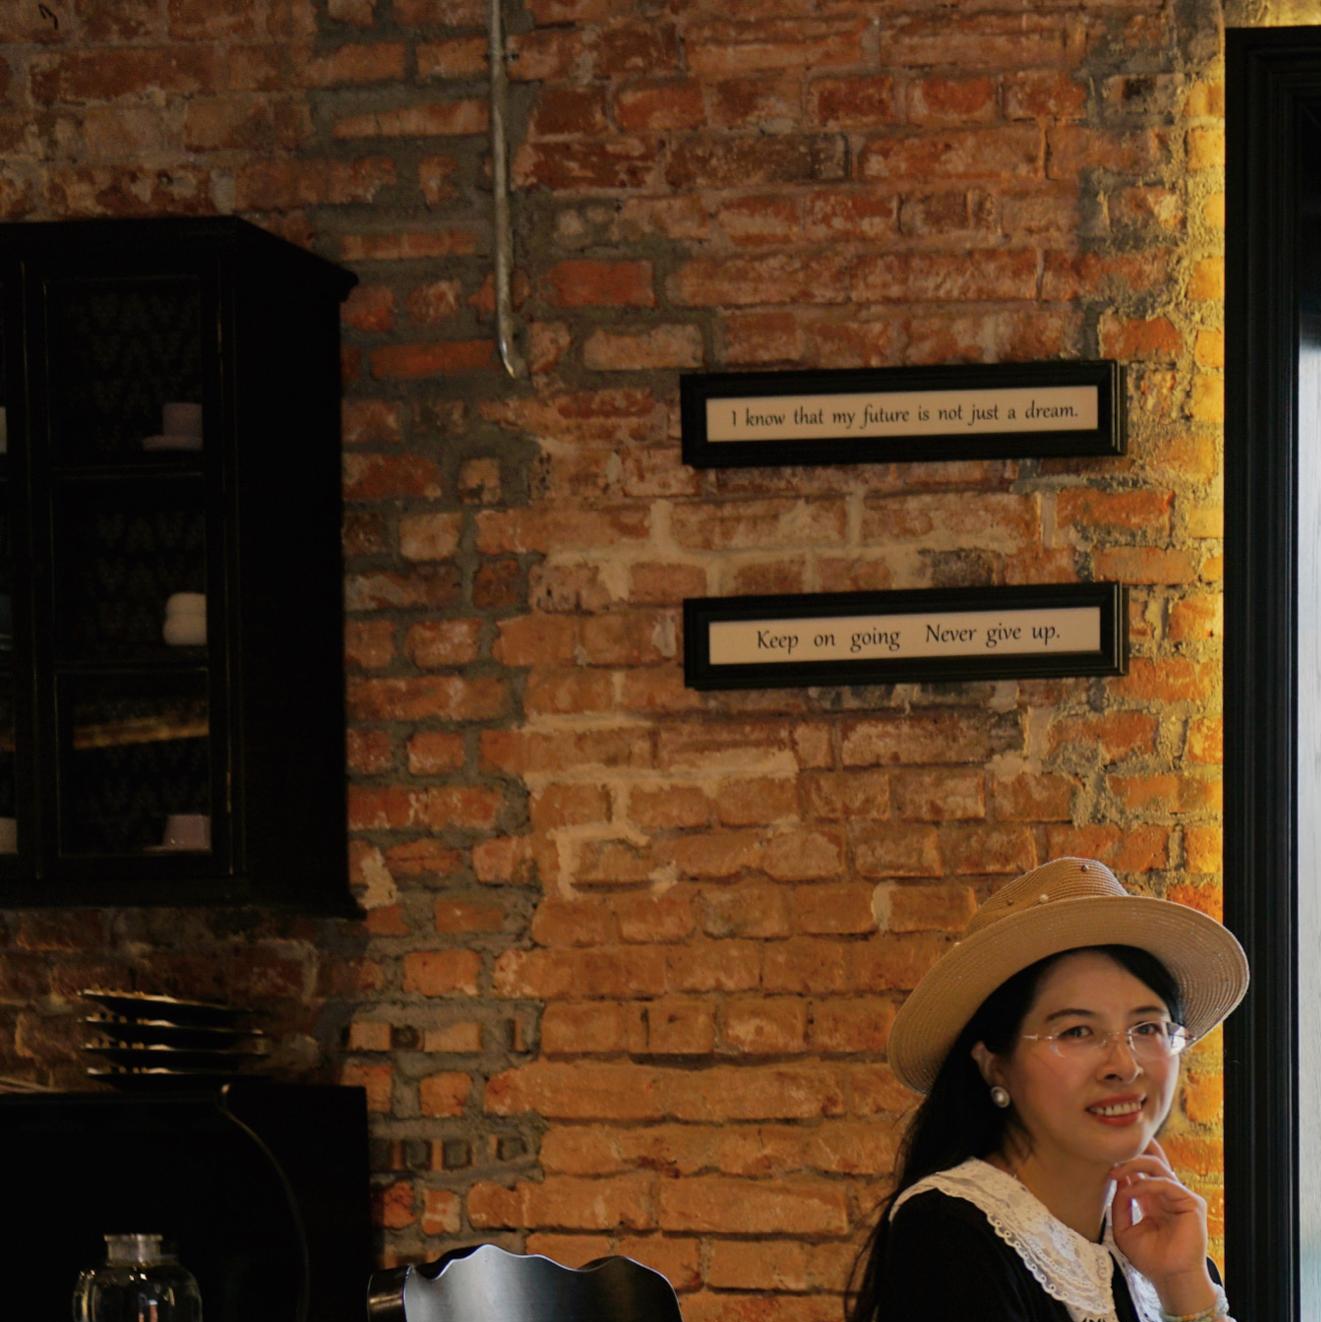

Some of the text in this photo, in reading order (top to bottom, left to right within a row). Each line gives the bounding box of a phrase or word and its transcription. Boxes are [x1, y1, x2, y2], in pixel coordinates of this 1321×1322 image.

[745, 407, 786, 427] know
[794, 407, 824, 426] that
[832, 410, 855, 428] my
[859, 405, 910, 429] future
[918, 405, 930, 421] is
[938, 406, 962, 421] not
[968, 403, 999, 426] just
[1007, 409, 1016, 420] a
[1025, 400, 1079, 420] dream.
[757, 622, 1061, 654] Keep on going Never give up.
